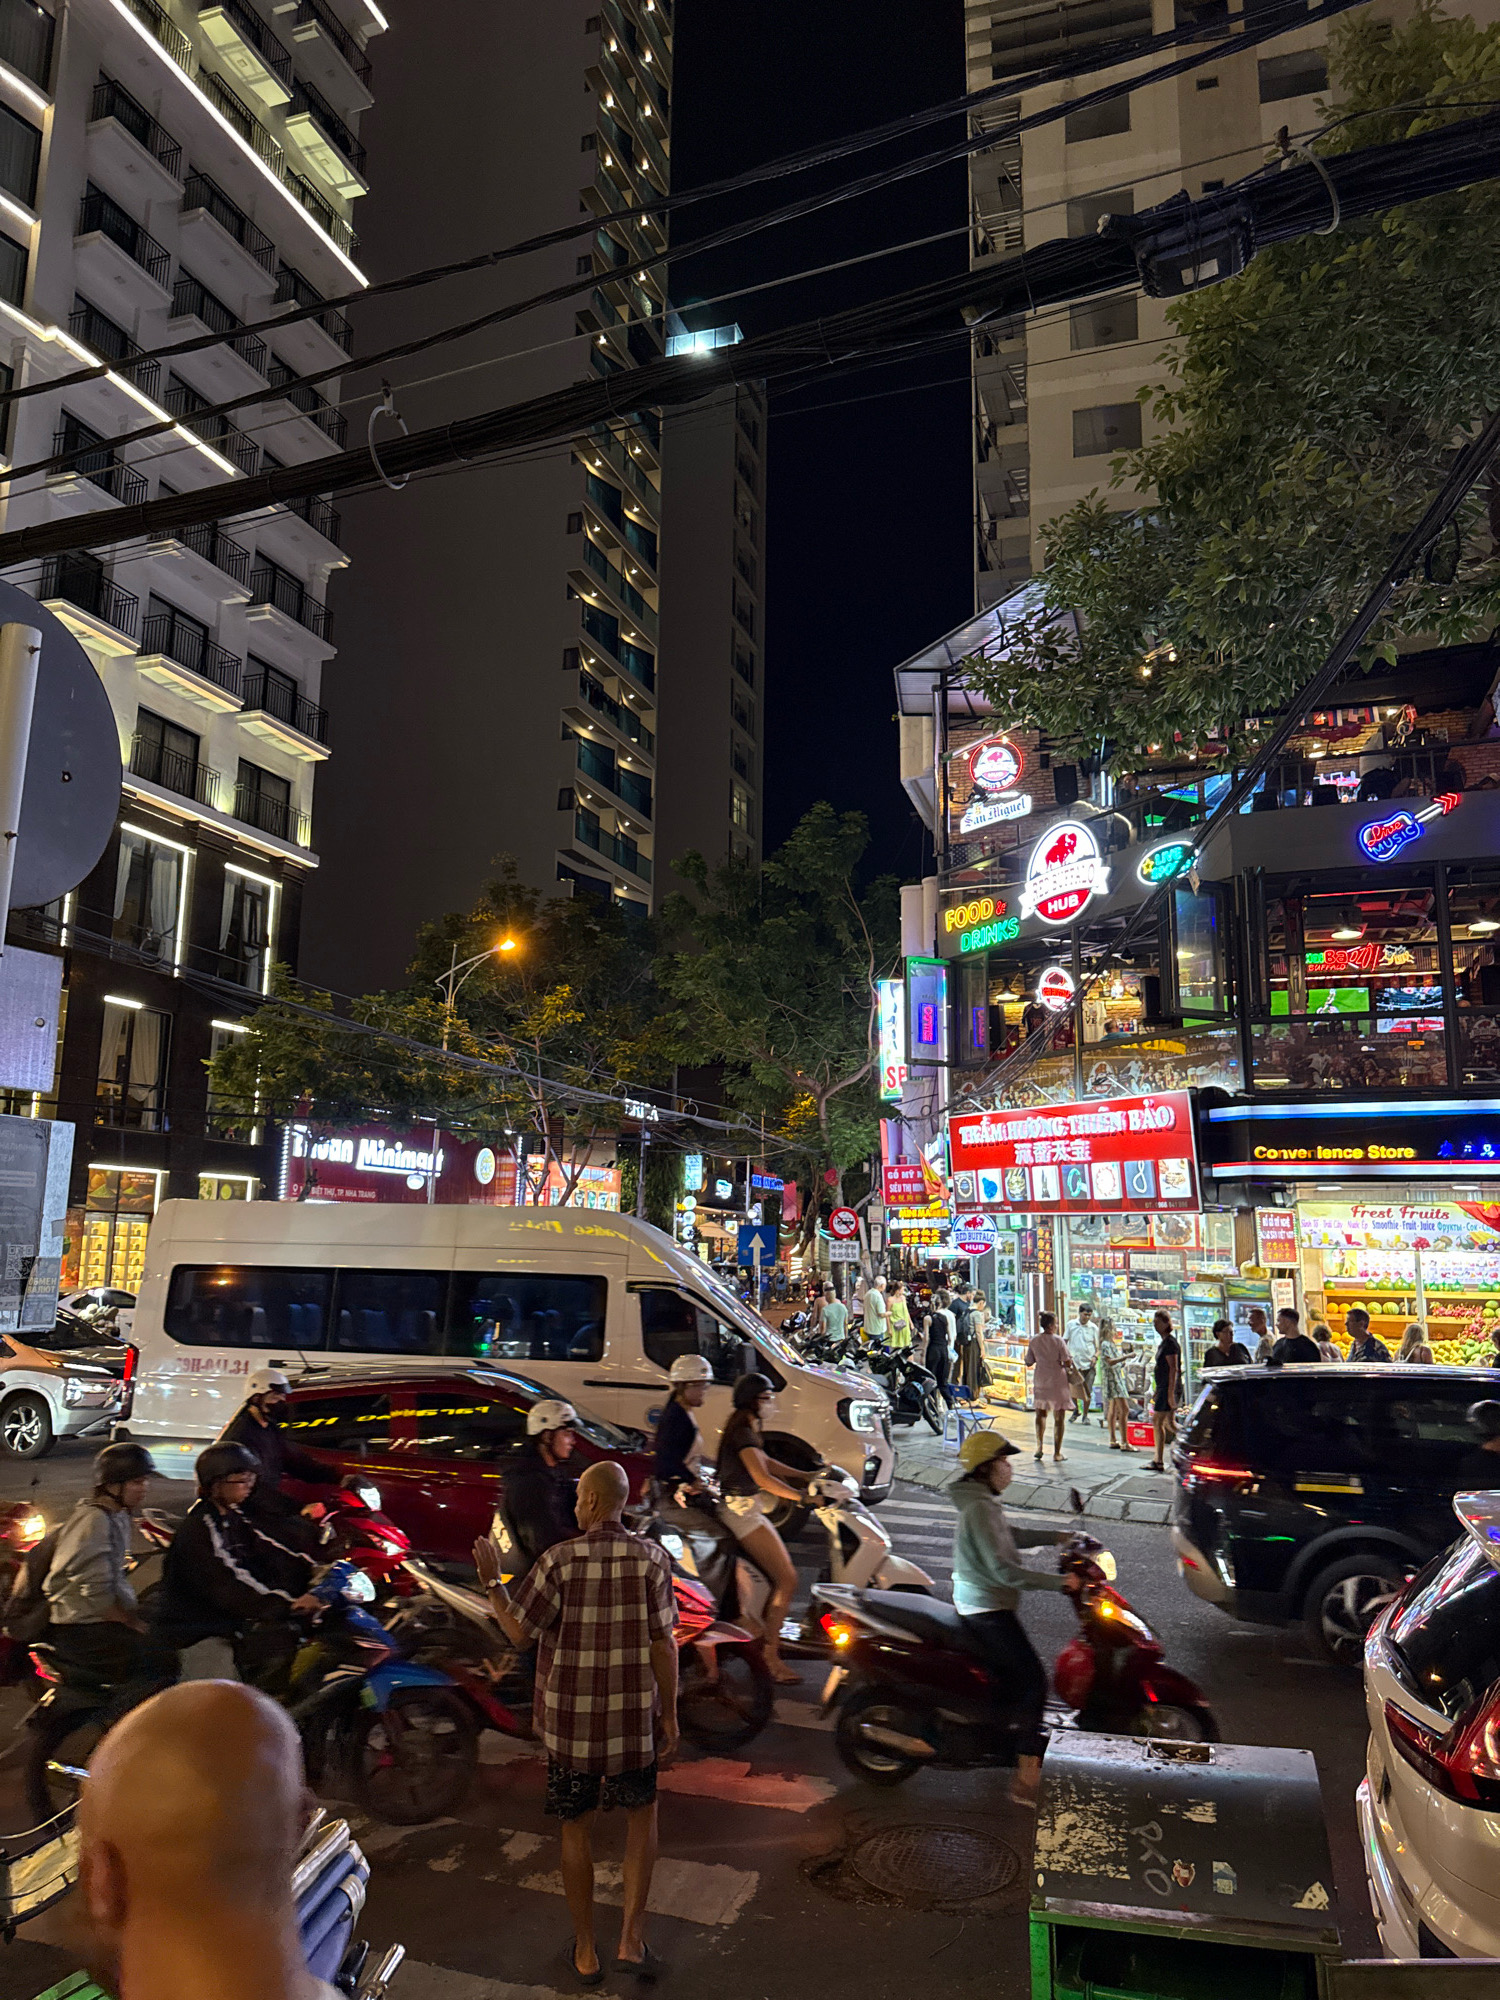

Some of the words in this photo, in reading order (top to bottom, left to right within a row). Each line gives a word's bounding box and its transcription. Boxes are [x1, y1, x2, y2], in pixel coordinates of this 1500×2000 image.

[964, 810, 987, 827] San
[987, 797, 1026, 821] Miguel
[1367, 821, 1403, 847] Live
[1372, 825, 1416, 854] MUSIC
[1154, 846, 1183, 866] LIVE
[1047, 894, 1079, 914] HUB
[945, 897, 995, 933] FOOD
[995, 900, 1008, 916] &
[959, 916, 1021, 953] DRINKS
[1129, 1098, 1176, 1131] BẢO
[1253, 1144, 1364, 1160] Convenience
[1367, 1143, 1415, 1160] Store
[345, 1189, 357, 1198] NHA
[358, 1190, 376, 1199] TRANG
[1350, 1205, 1394, 1219] Frest
[1399, 1205, 1450, 1220] Fruits
[1372, 1219, 1399, 1230] Smoothie
[1402, 1220, 1417, 1231] Fruit
[1420, 1220, 1435, 1231] Juice
[1437, 1221, 1463, 1233] Фрукты
[955, 1233, 967, 1243] RED
[968, 1232, 995, 1243] BUFFALO
[27, 1285, 56, 1294] ВАЛЮТ
[28, 1276, 57, 1287] ОБМЕН
